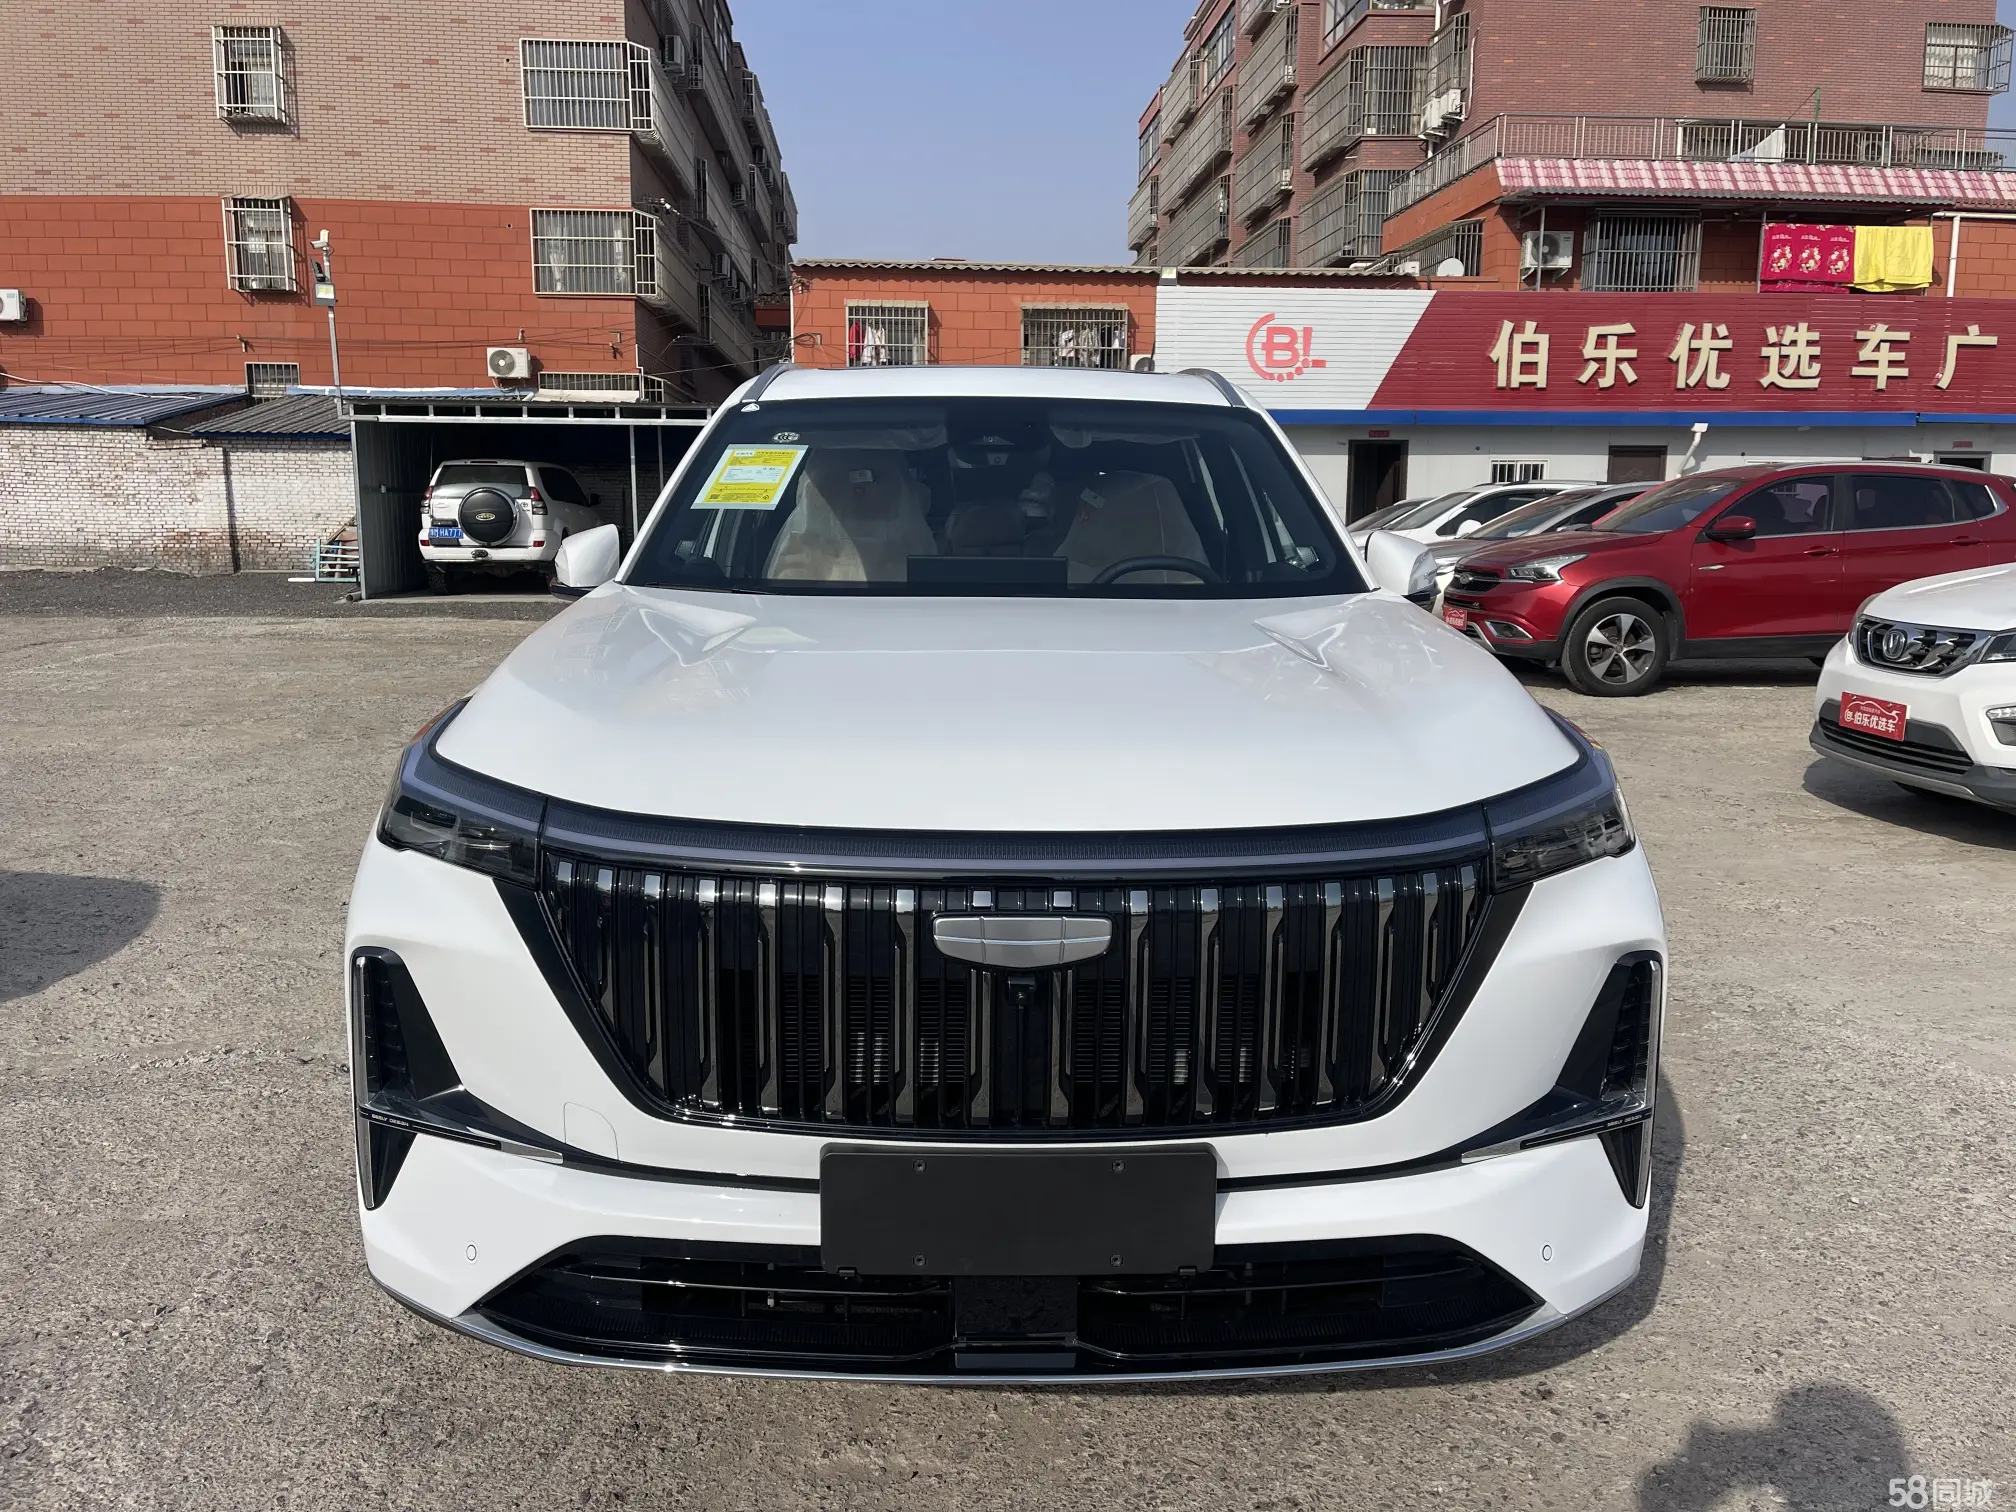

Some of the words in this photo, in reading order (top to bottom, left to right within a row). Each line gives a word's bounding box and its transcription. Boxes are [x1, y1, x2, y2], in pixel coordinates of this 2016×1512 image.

[1489, 320, 1999, 390] 伯乐优选车广
[1854, 712, 1896, 733] 伯乐优选车
